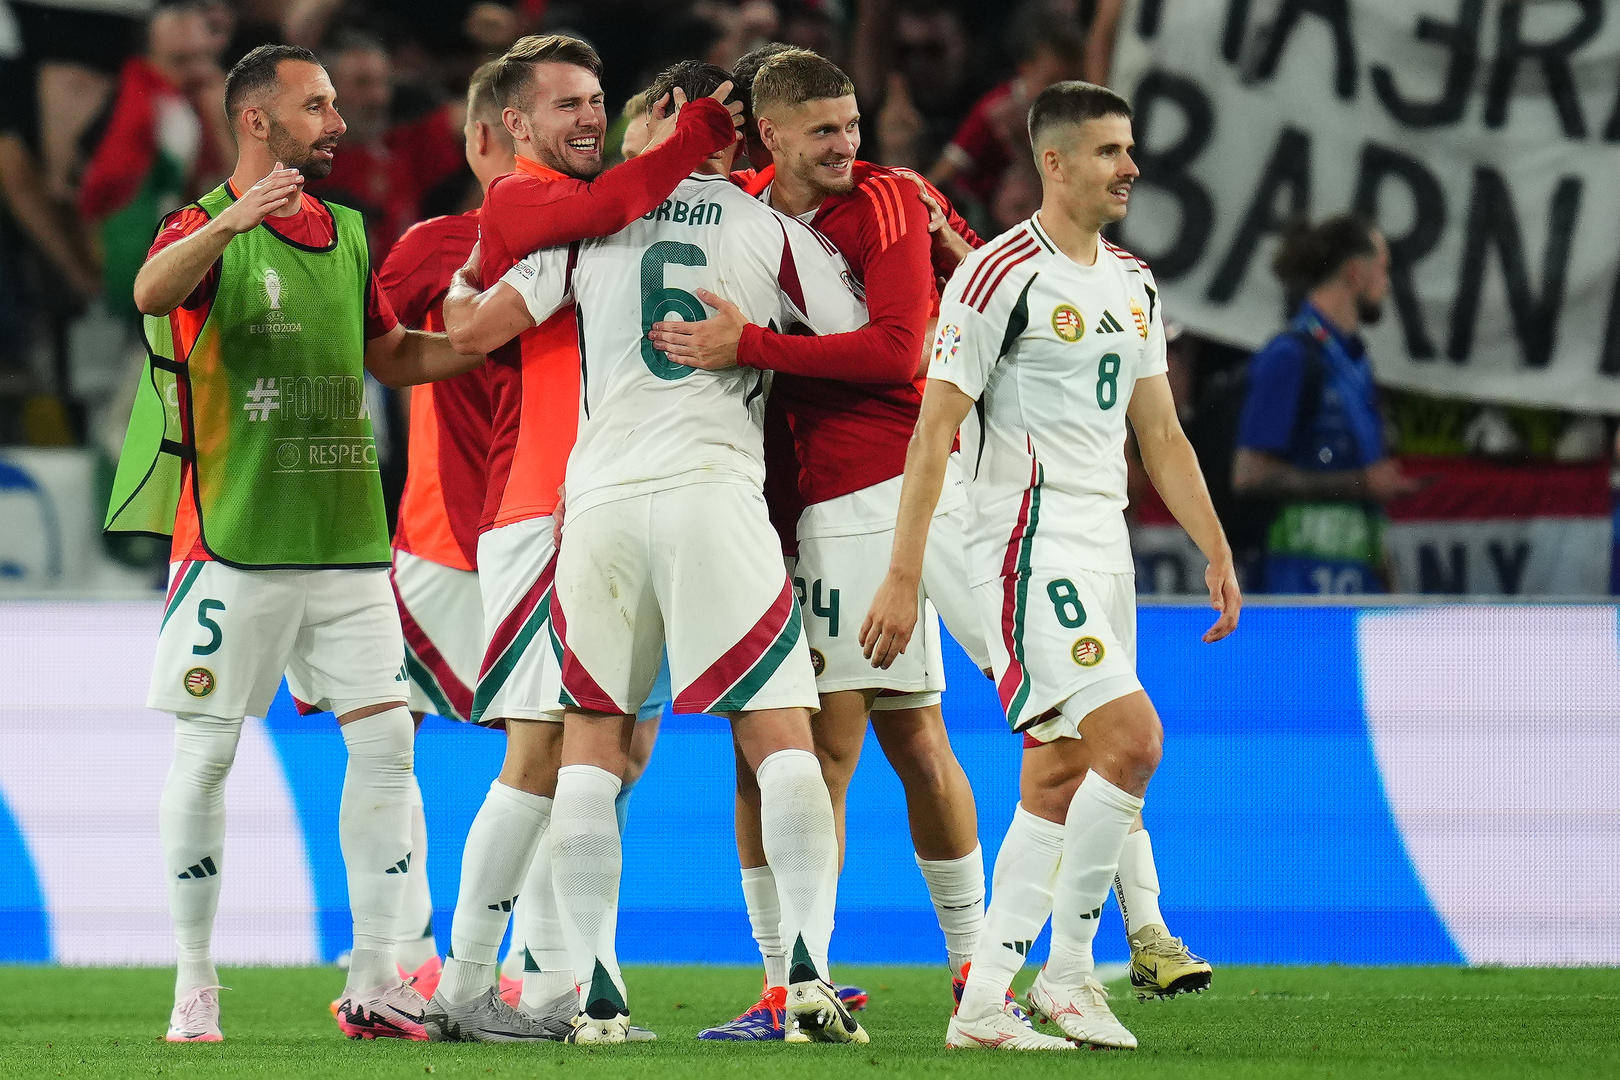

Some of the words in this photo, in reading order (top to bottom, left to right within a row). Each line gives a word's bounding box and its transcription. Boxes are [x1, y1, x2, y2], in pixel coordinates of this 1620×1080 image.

[1103, 66, 1620, 376] BARN
[641, 241, 707, 381] 6
[1096, 353, 1121, 410] 8
[309, 445, 377, 465] RESPEC
[192, 598, 226, 656] 5
[1046, 578, 1087, 629] 8
